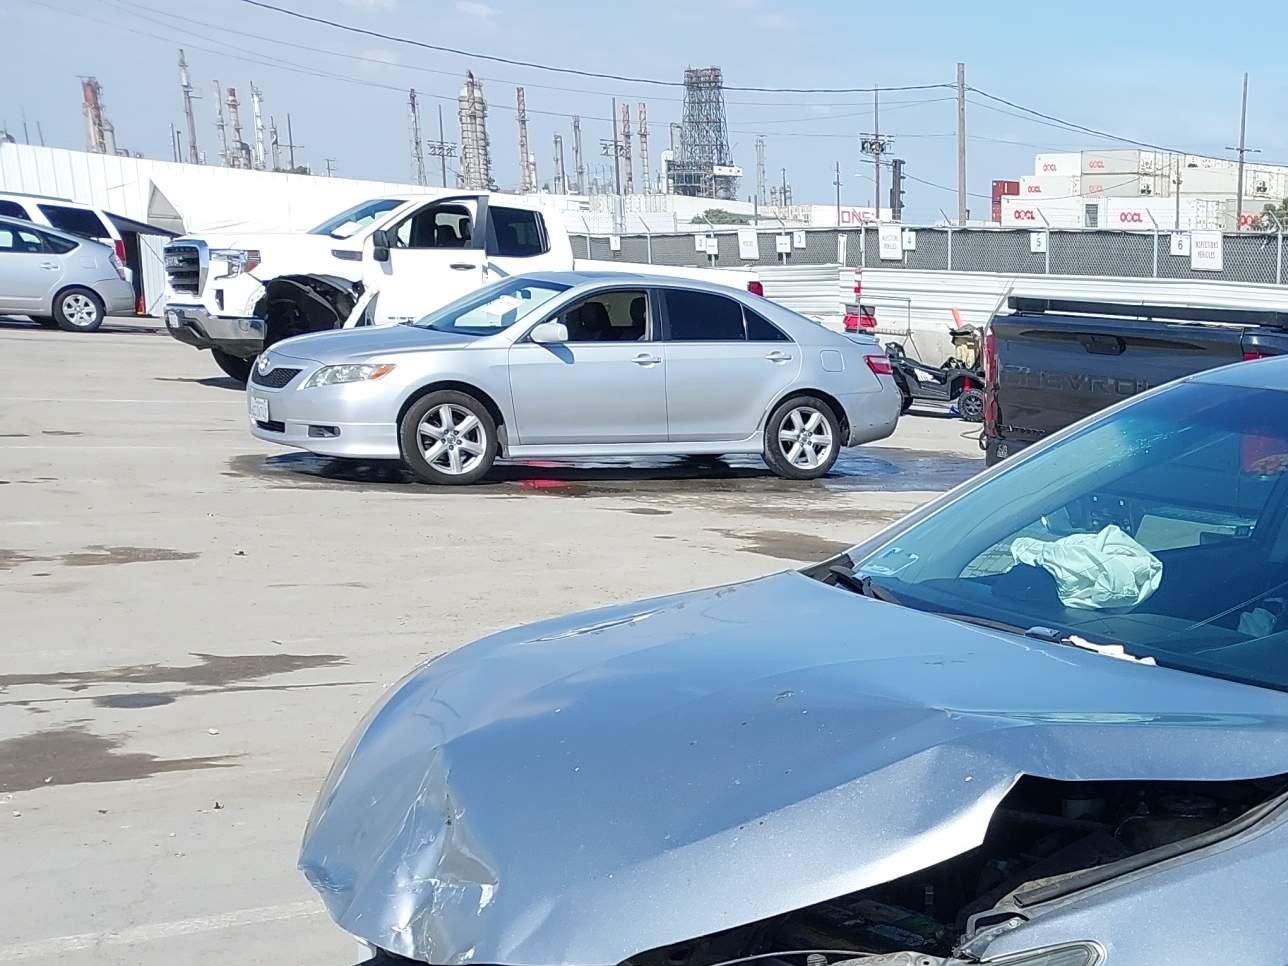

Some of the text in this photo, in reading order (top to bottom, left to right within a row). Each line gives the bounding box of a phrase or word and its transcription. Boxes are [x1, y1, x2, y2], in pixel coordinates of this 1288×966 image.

[1013, 209, 1036, 221] OOCL
[1119, 211, 1143, 223] OOCL
[1177, 239, 1184, 250] 6
